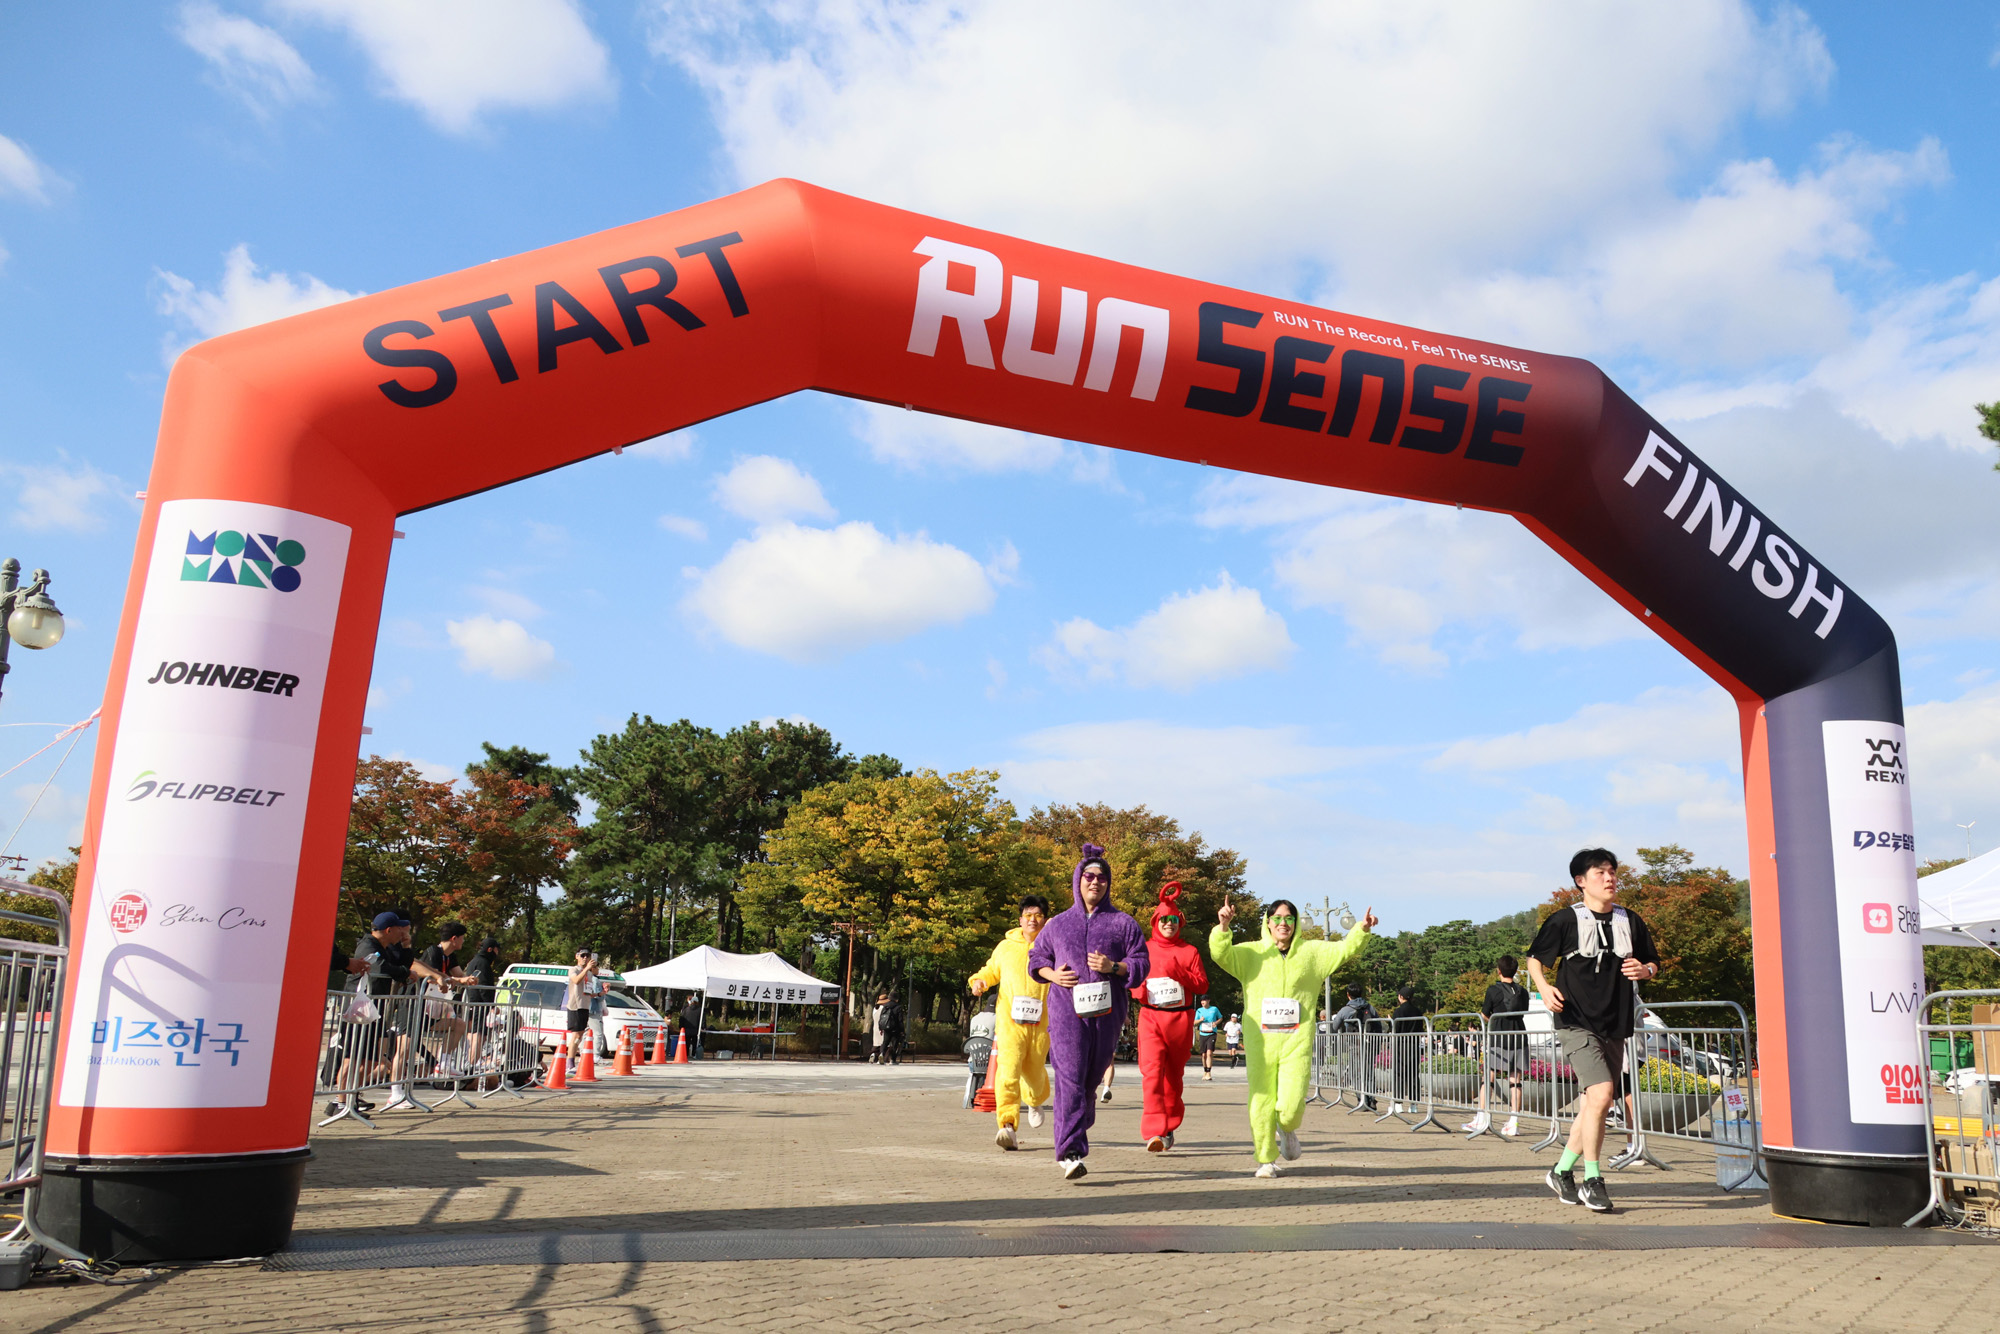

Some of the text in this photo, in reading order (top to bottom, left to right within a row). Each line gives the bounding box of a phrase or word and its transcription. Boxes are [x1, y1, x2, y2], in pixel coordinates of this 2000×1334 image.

[362, 230, 750, 409] START
[1273, 311, 1530, 373] RUN The Record, Feel The SENSE
[1623, 429, 1844, 640] FINISH
[147, 661, 300, 697] JOHNBER
[1865, 769, 1905, 785] REXY
[156, 782, 285, 807] FLIPBELT
[160, 903, 212, 926] Skin
[1087, 993, 1107, 1002] 1727
[1160, 987, 1178, 996] 1728
[90, 1016, 249, 1066] 비즈한국
